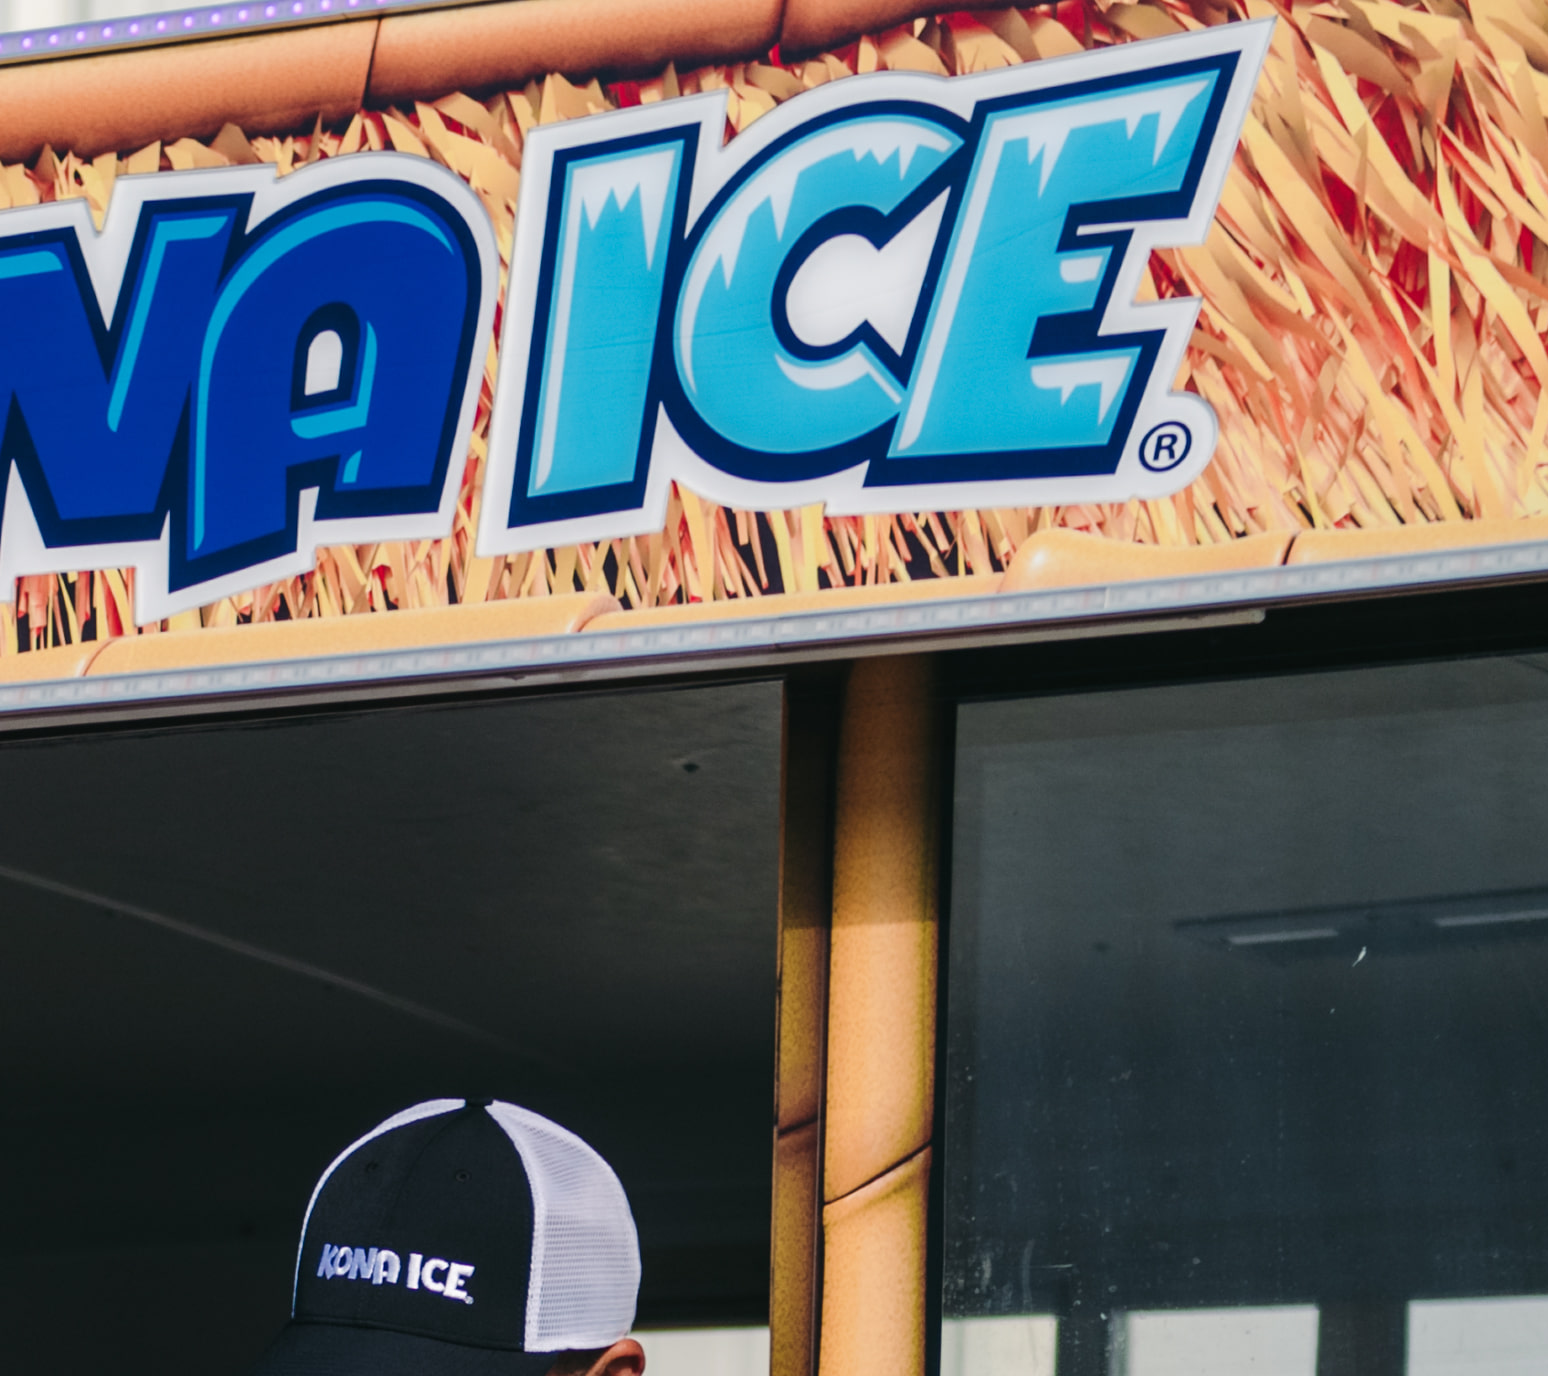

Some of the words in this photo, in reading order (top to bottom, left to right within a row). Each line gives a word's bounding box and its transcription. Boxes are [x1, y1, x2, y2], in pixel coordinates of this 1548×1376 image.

[499, 40, 1256, 532] ICE
[316, 1243, 402, 1285] KONA
[406, 1252, 475, 1301] ICE
